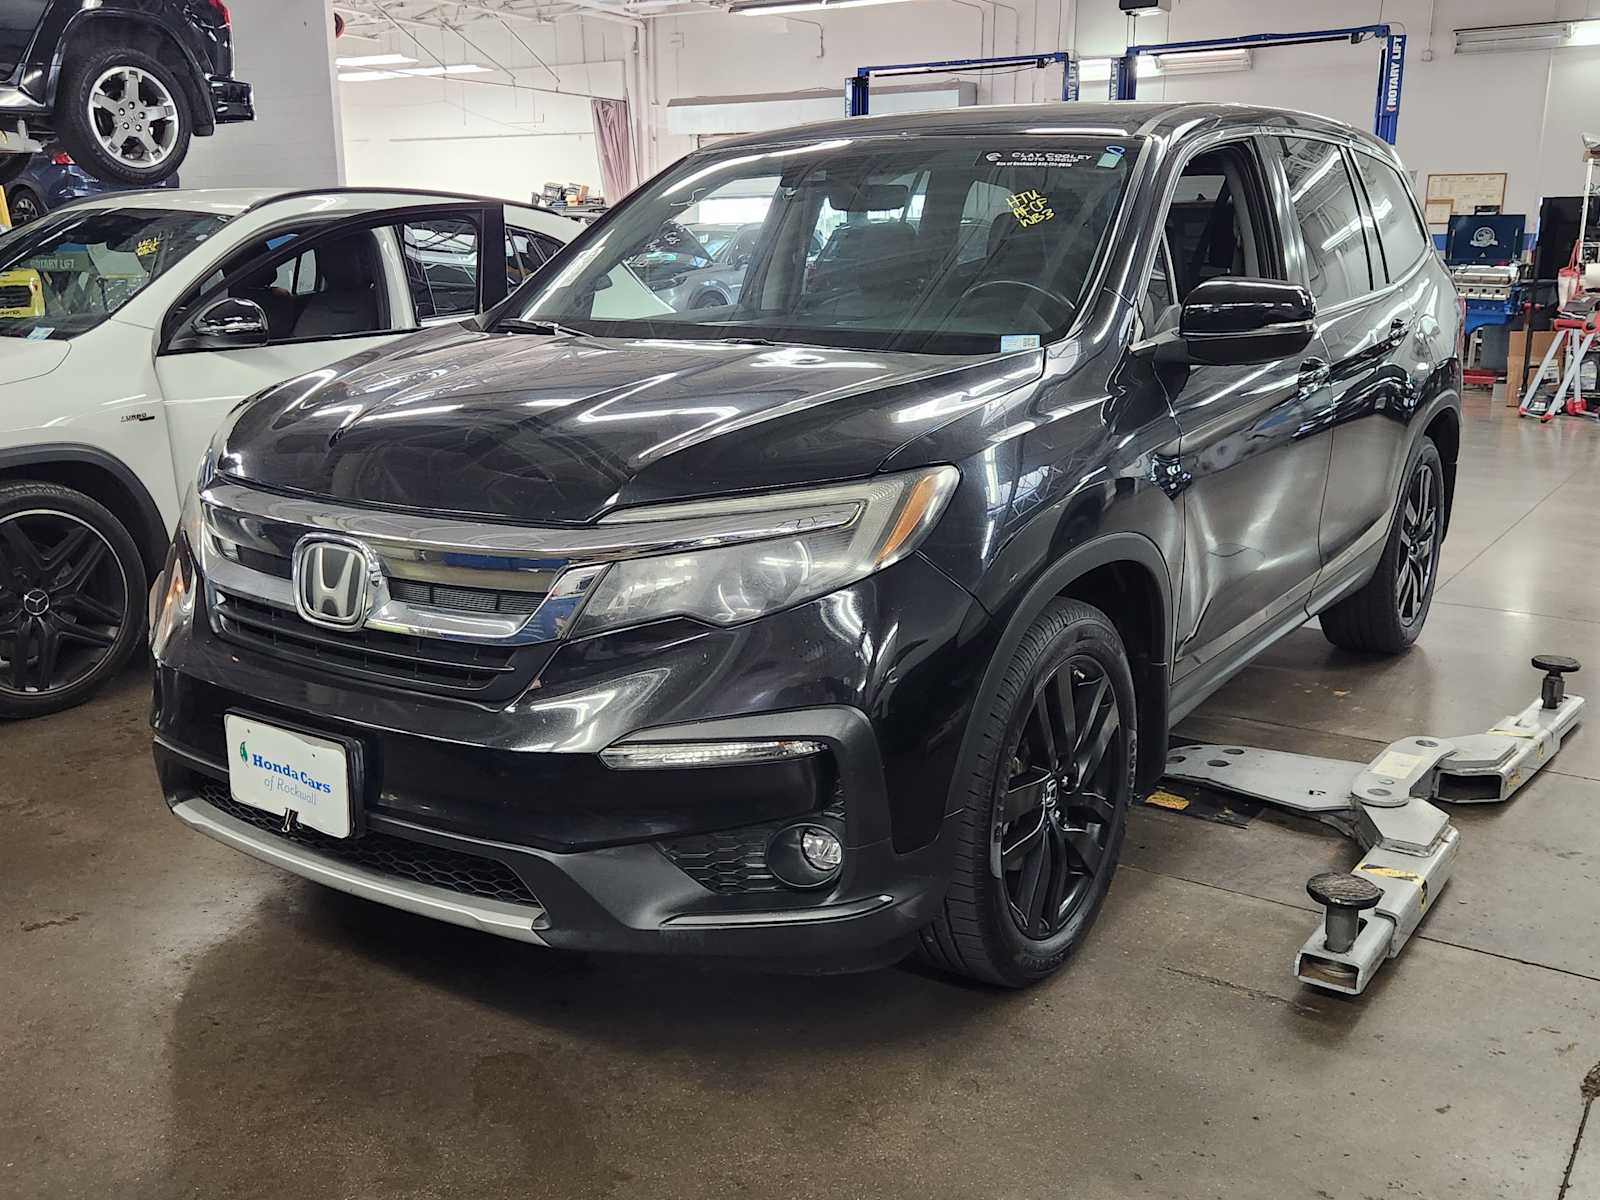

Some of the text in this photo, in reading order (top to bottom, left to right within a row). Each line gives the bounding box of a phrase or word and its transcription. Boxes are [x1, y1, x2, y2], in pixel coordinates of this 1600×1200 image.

[1386, 36, 1403, 106] ROTARY LIFT
[1045, 152, 1092, 160] COOLEY
[252, 753, 332, 794] Honda Cars
[264, 776, 317, 805] of Rockwall
